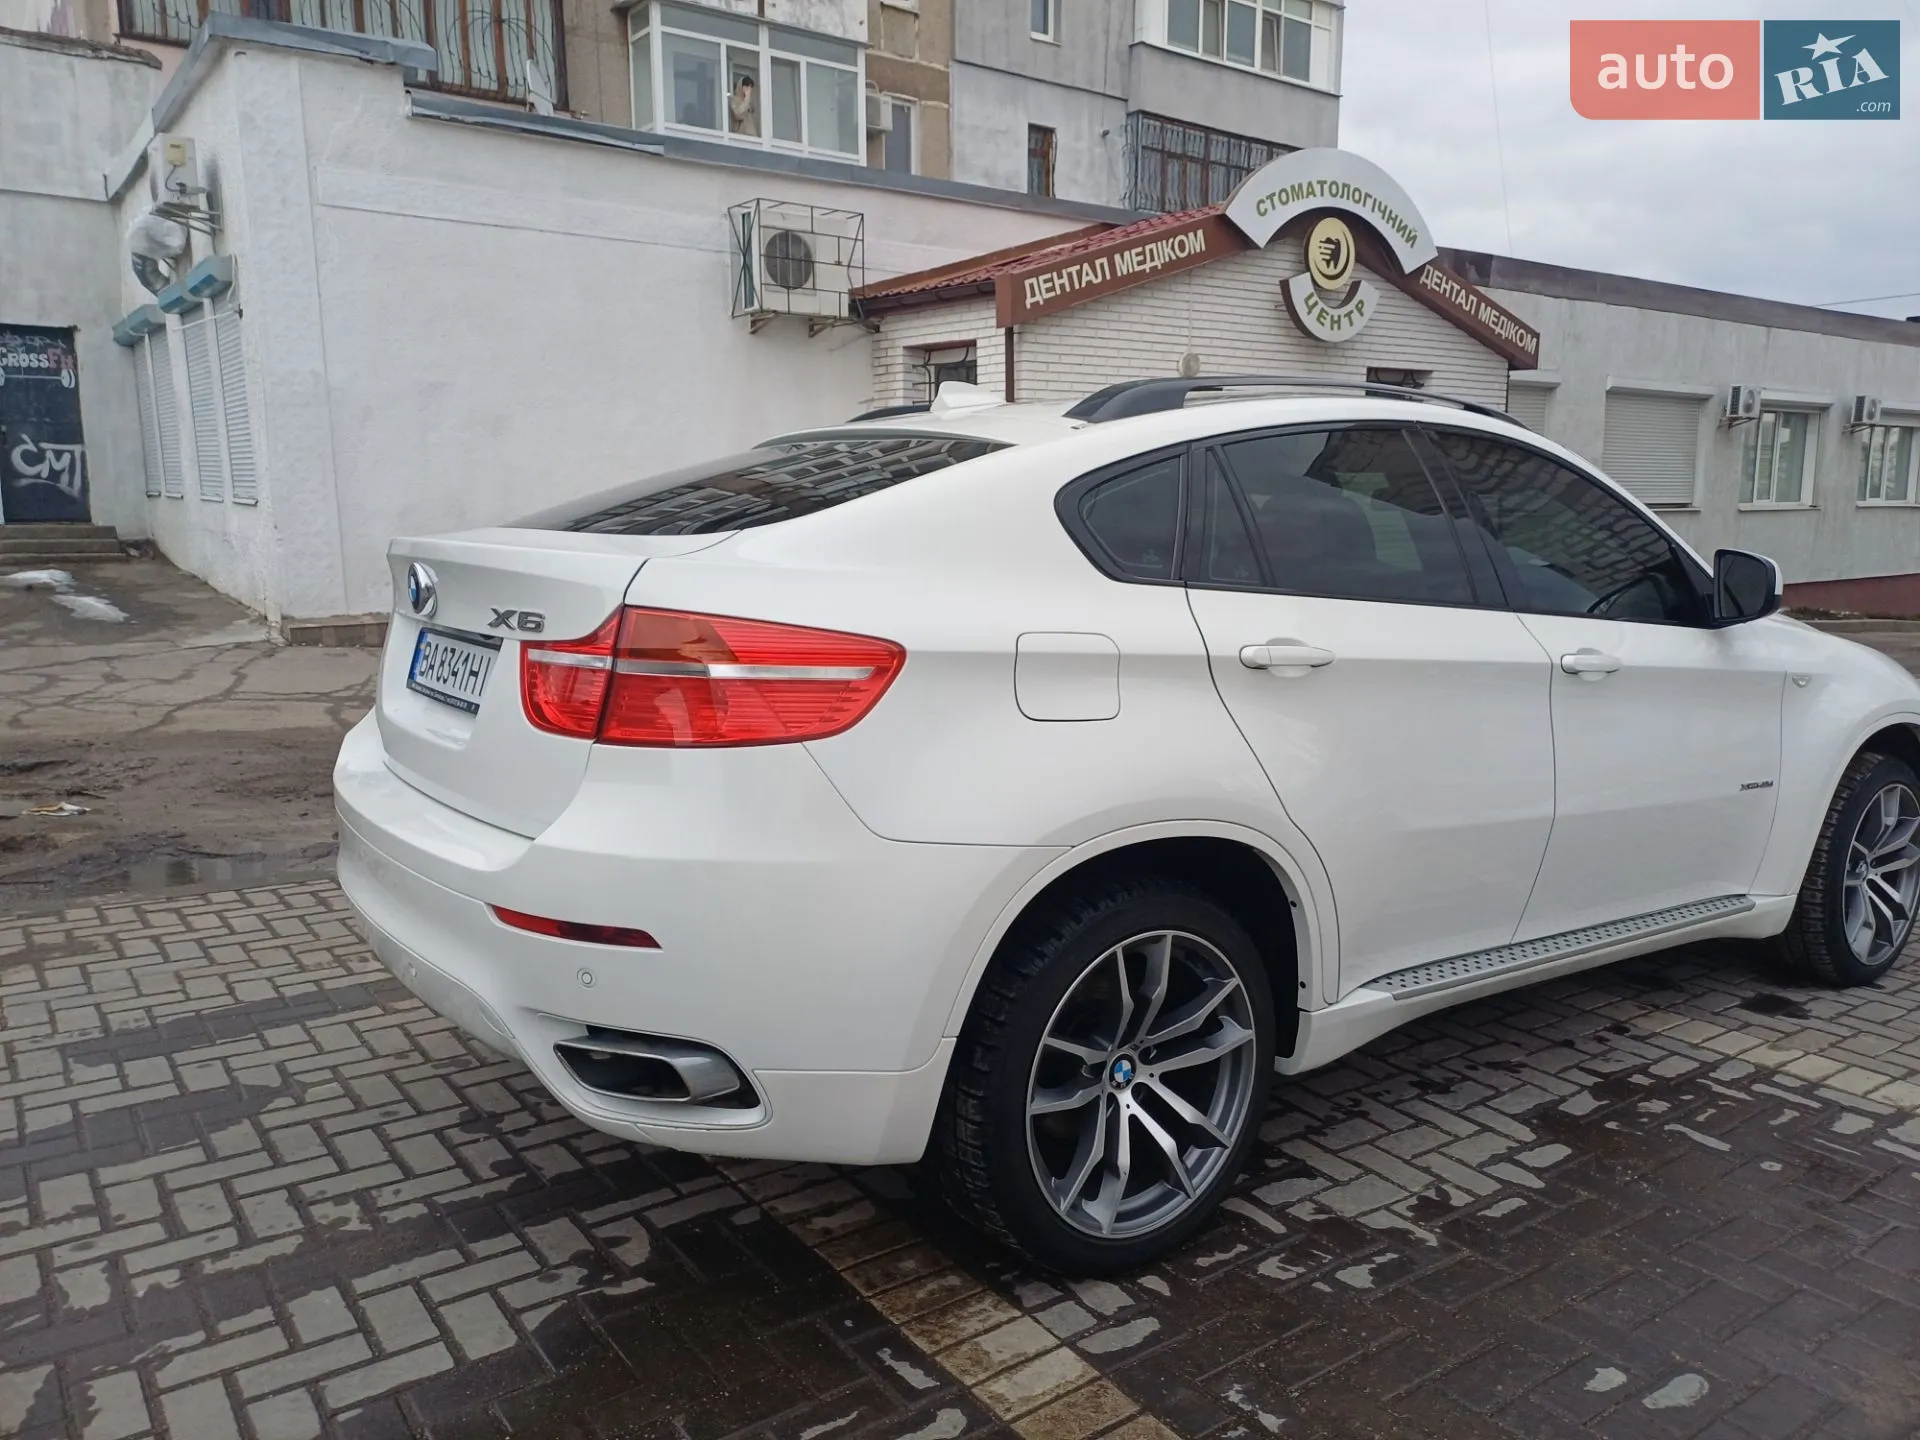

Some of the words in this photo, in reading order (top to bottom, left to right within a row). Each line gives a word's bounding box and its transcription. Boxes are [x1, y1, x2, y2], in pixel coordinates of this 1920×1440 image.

[1256, 180, 1418, 249] СТОМАТОЛОГІЧНИЙ
[1024, 256, 1110, 309] ДЕНТАЛ
[1114, 229, 1206, 275] МЕДІКОМ
[1303, 292, 1366, 332] ЦЕНТР
[1420, 265, 1478, 315] ДЕНТАЛ
[1478, 302, 1536, 355] МЕДІКОМ
[488, 608, 545, 632] X6
